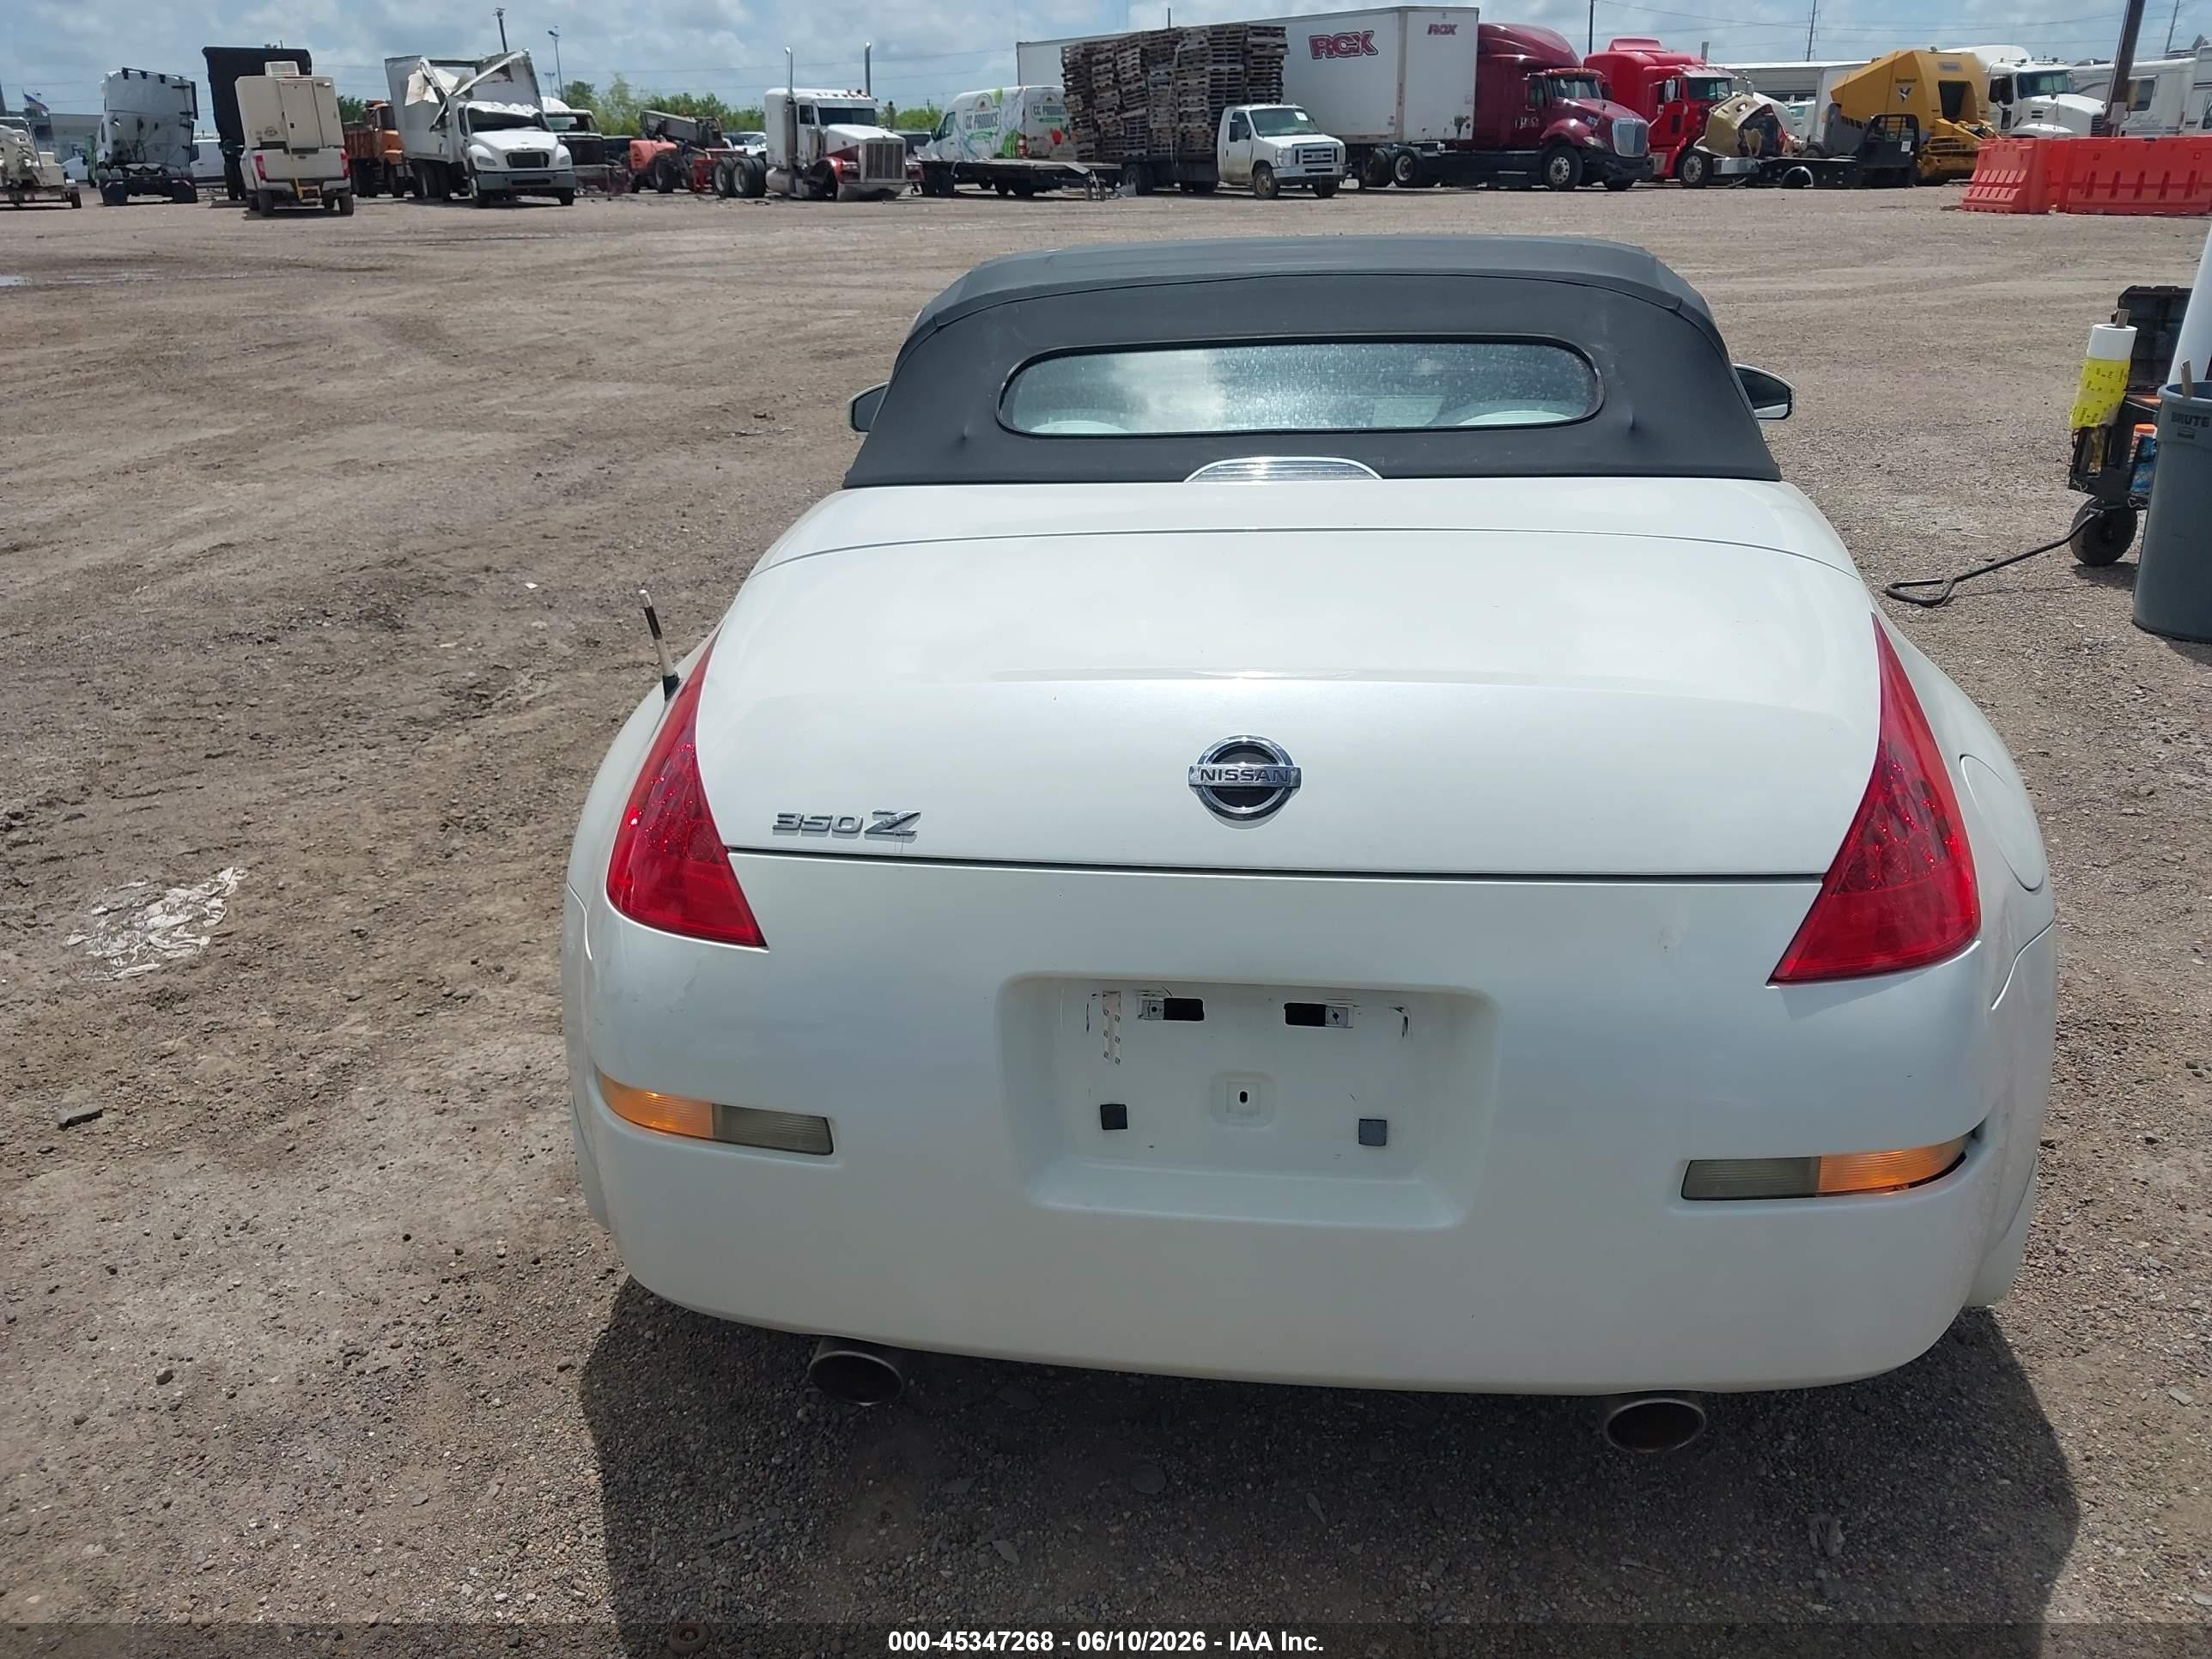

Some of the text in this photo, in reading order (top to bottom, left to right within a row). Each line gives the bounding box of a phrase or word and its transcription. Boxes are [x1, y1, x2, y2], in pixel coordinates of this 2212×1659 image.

[1309, 30, 1378, 59] RCX
[975, 112, 999, 129] PRODUCE
[2171, 412, 2210, 428] BRUTE
[1200, 769, 1290, 783] NISSAN
